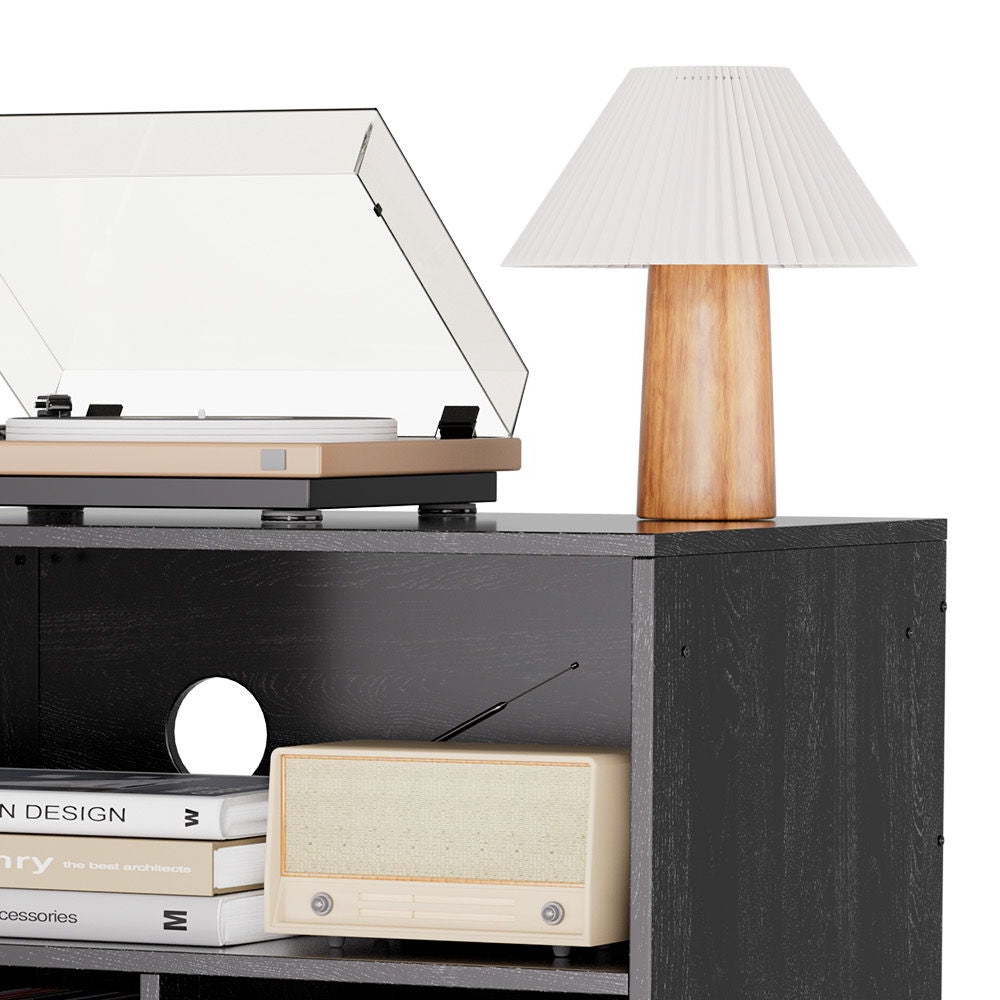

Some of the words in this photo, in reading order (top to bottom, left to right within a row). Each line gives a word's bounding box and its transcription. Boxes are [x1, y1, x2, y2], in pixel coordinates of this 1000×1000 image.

[25, 804, 126, 823] DESIGN
[62, 860, 86, 869] the
[88, 861, 120, 871] best
[122, 863, 192, 874] architects
